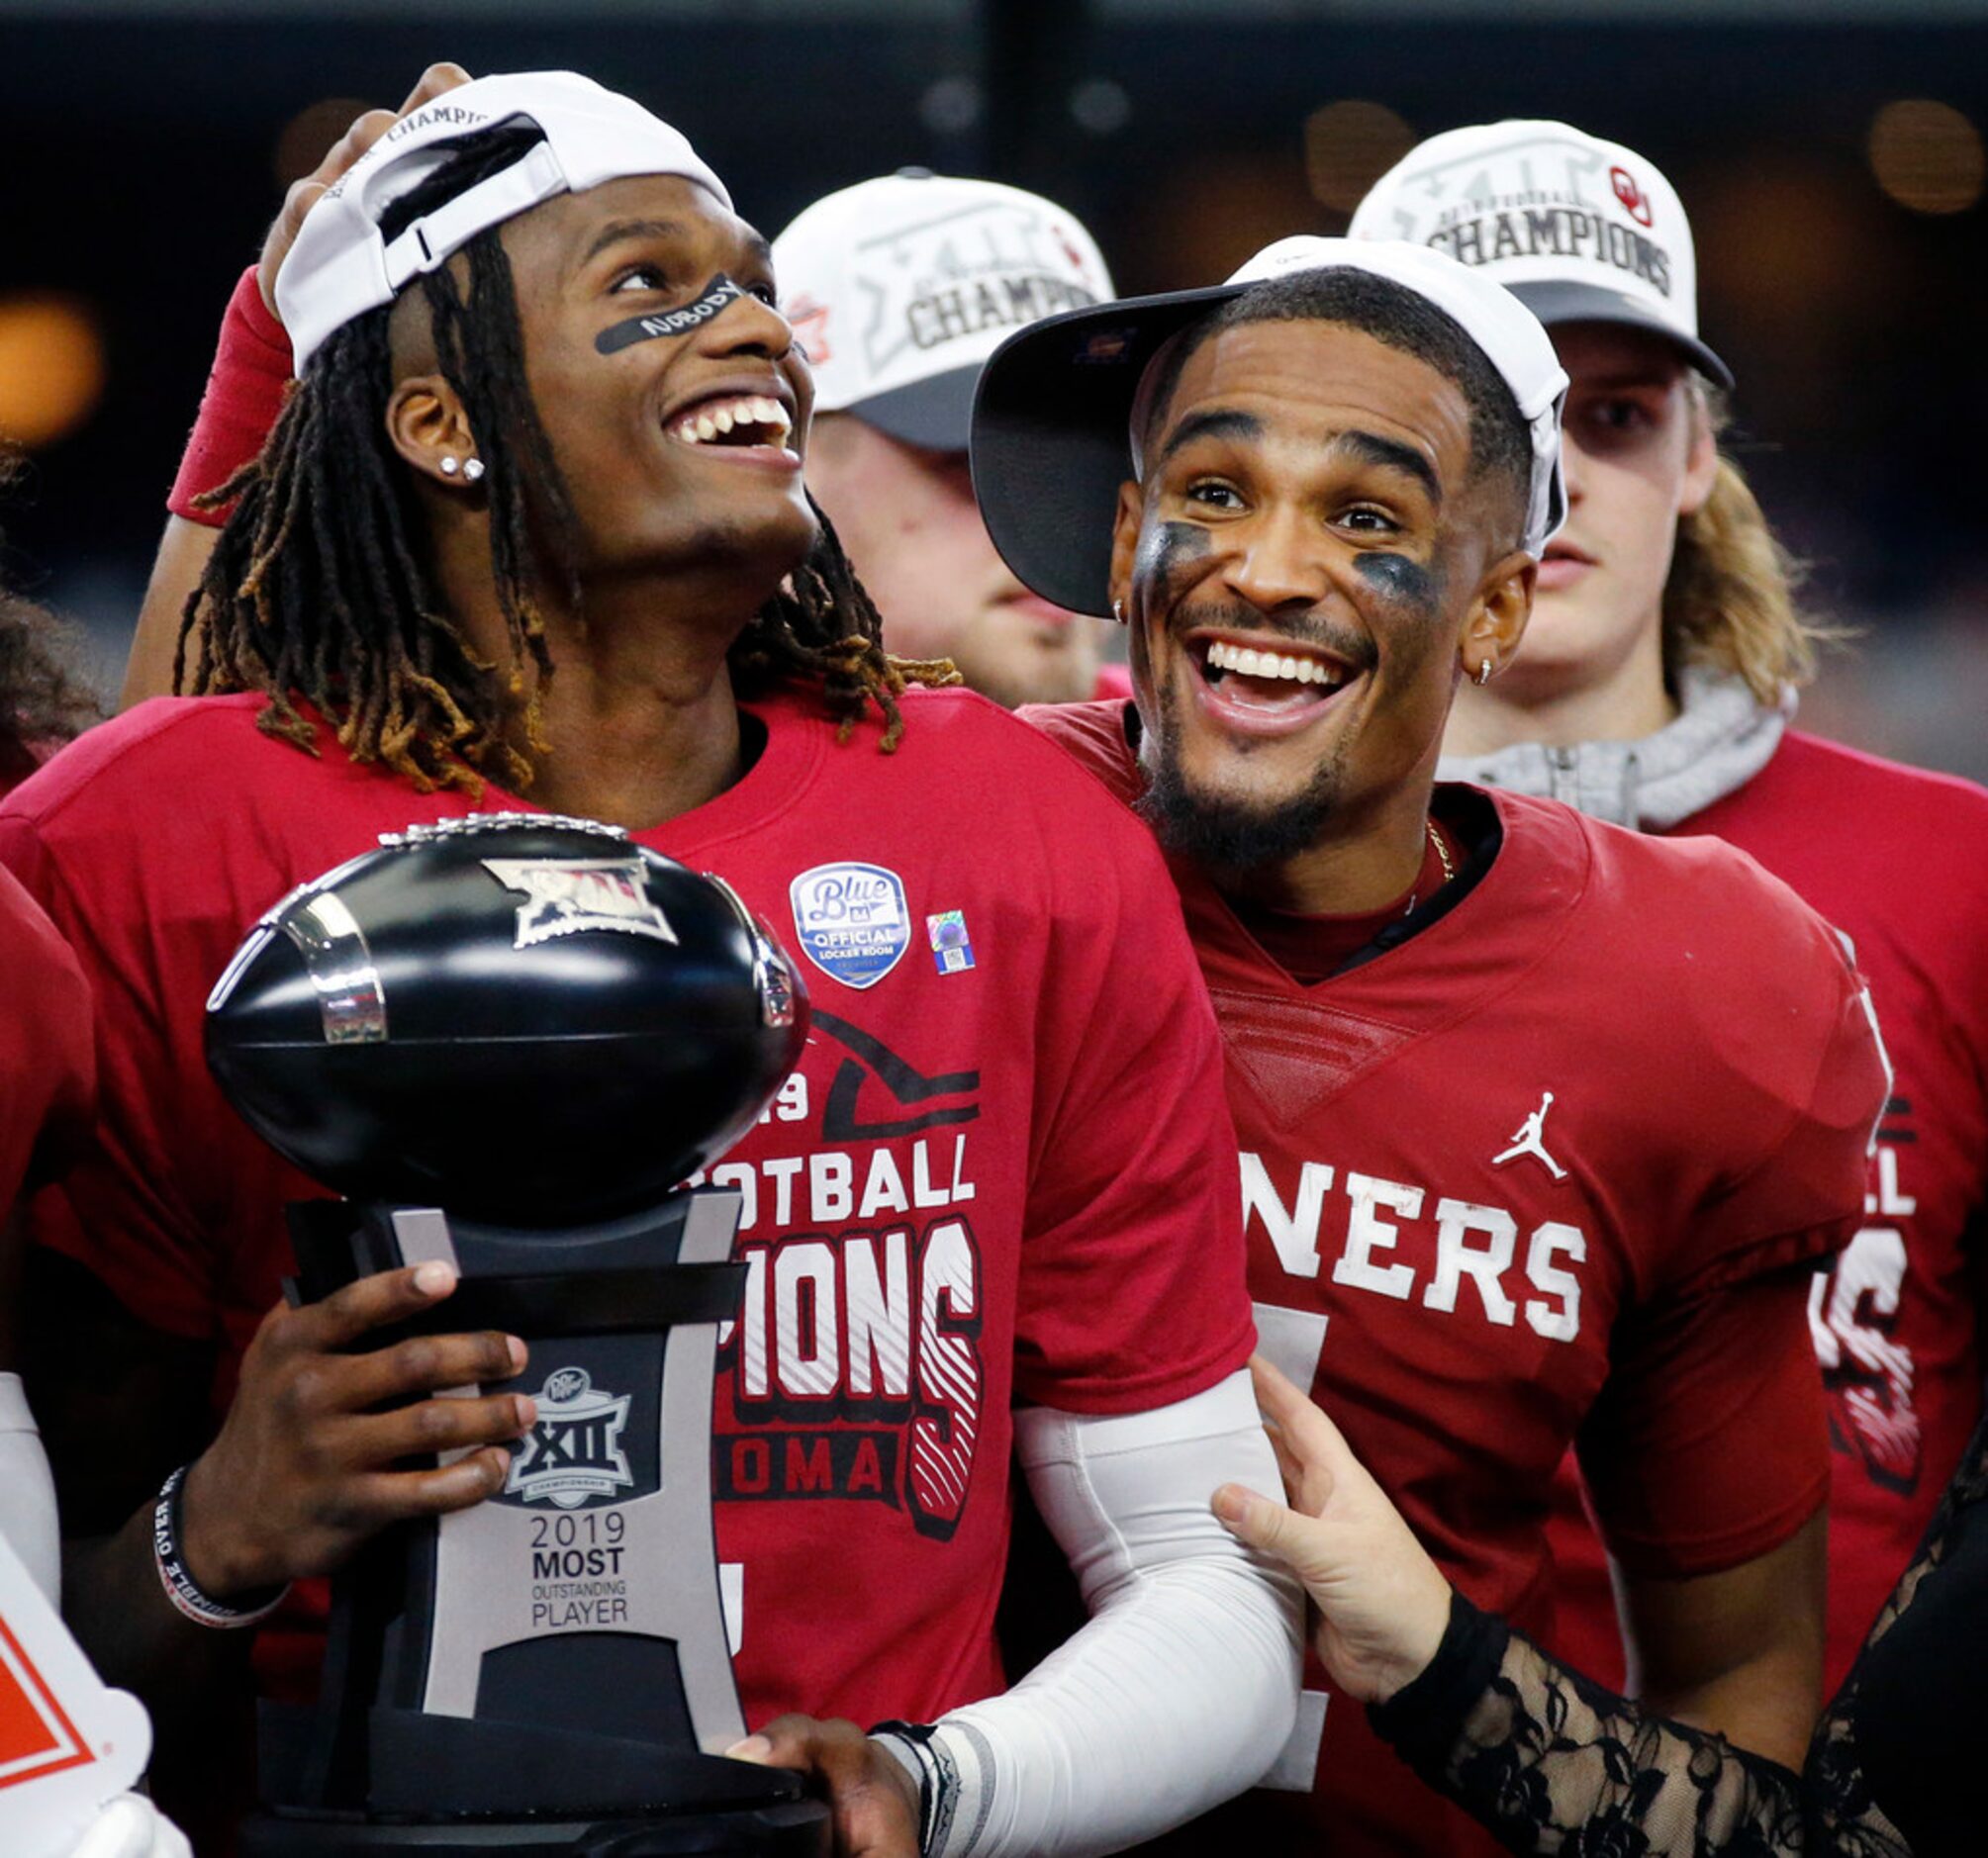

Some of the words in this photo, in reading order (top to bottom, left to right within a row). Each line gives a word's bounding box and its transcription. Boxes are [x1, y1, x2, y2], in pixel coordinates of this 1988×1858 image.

[640, 279, 742, 336] NOBODY
[808, 877, 889, 921] Blue
[813, 929, 897, 948] OFFICIAL
[819, 949, 861, 960] LOCKER
[862, 946, 895, 957] ROOM
[1238, 1152, 1587, 1344] NERS
[718, 1221, 978, 1514] IONS
[154, 1501, 173, 1556] OVER
[529, 1511, 625, 1548] 2019
[532, 1546, 625, 1580] MOST
[531, 1580, 626, 1601] OUTSTANDING
[532, 1598, 628, 1627] PLAYER
